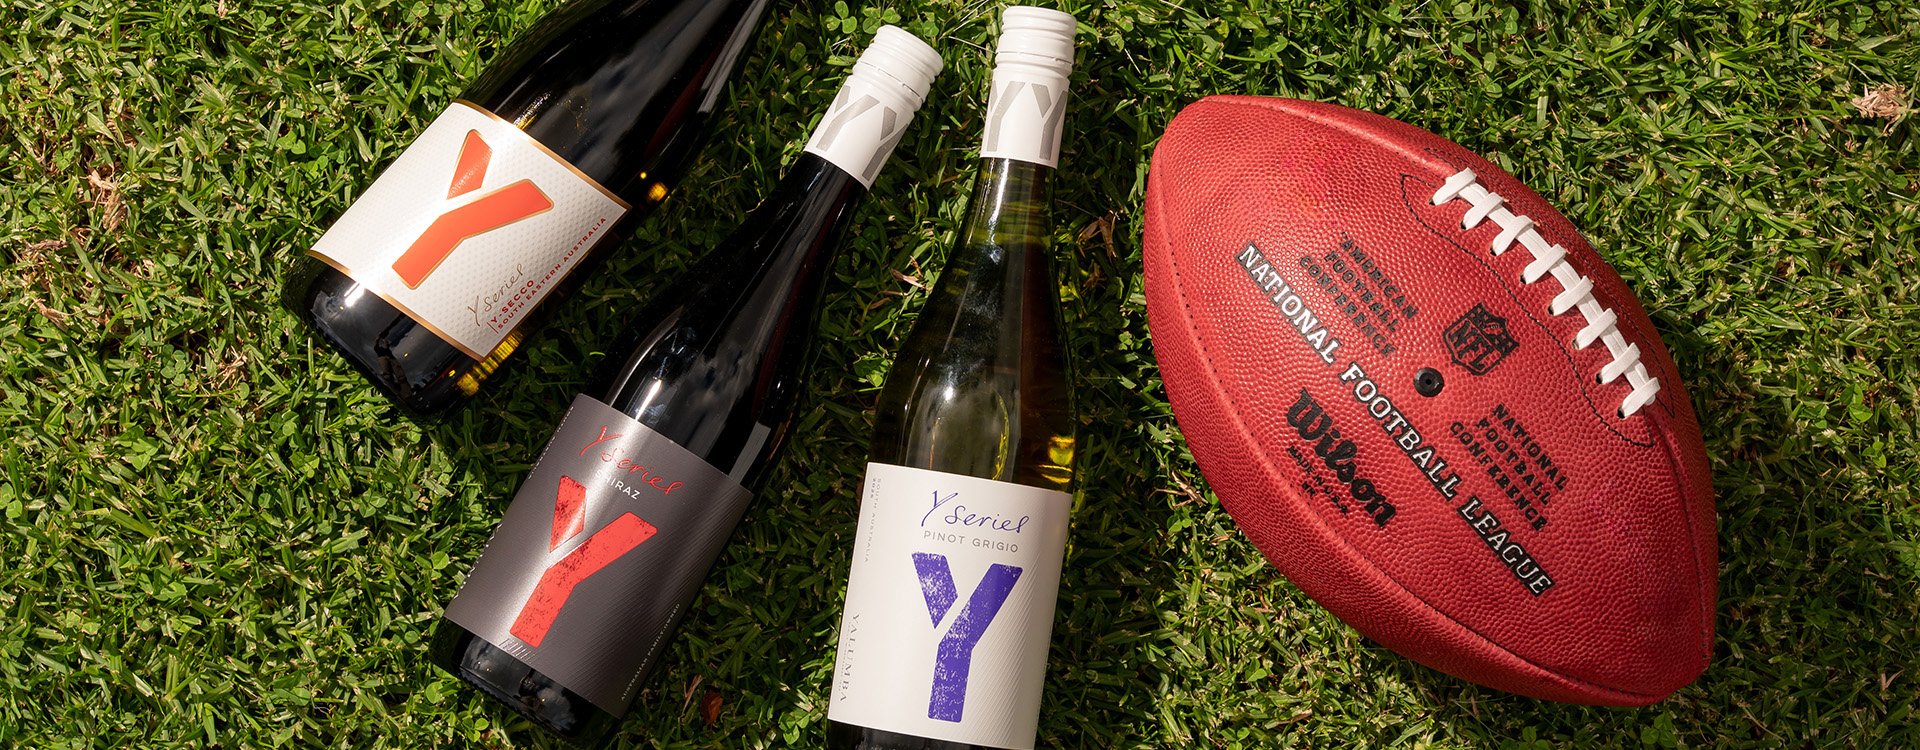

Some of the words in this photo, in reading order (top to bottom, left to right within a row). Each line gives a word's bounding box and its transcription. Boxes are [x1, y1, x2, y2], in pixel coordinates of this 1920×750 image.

[391, 128, 555, 290] Y
[467, 295, 481, 327] Y
[490, 279, 534, 324] Y-SECCO
[497, 302, 525, 329] SOUTH
[525, 263, 561, 300] EASTERN
[563, 217, 607, 263] AUSTRALIA
[1300, 255, 1396, 357] CONFERENCE
[1324, 250, 1398, 332] FOOTBALL
[1341, 238, 1418, 319] AMERICAN
[580, 425, 624, 457] Y
[1236, 243, 1342, 365] NATIONAL
[1338, 361, 1462, 500] FOOTBALL
[1457, 497, 1556, 596] LEAGUE
[1286, 387, 1397, 528] Wilson
[1287, 446, 1315, 476] MADE
[1475, 417, 1551, 506] FOOTBALL
[1491, 402, 1569, 490] NATIONAL
[594, 469, 641, 500] SHIRAZ
[921, 490, 958, 527] Y
[1449, 421, 1548, 532] CONFERENCE
[509, 475, 658, 648] Y
[924, 530, 965, 544] PINOT
[972, 538, 1019, 553] GRIGIO
[840, 614, 860, 701] YALUMBA
[911, 551, 1023, 723] Y
